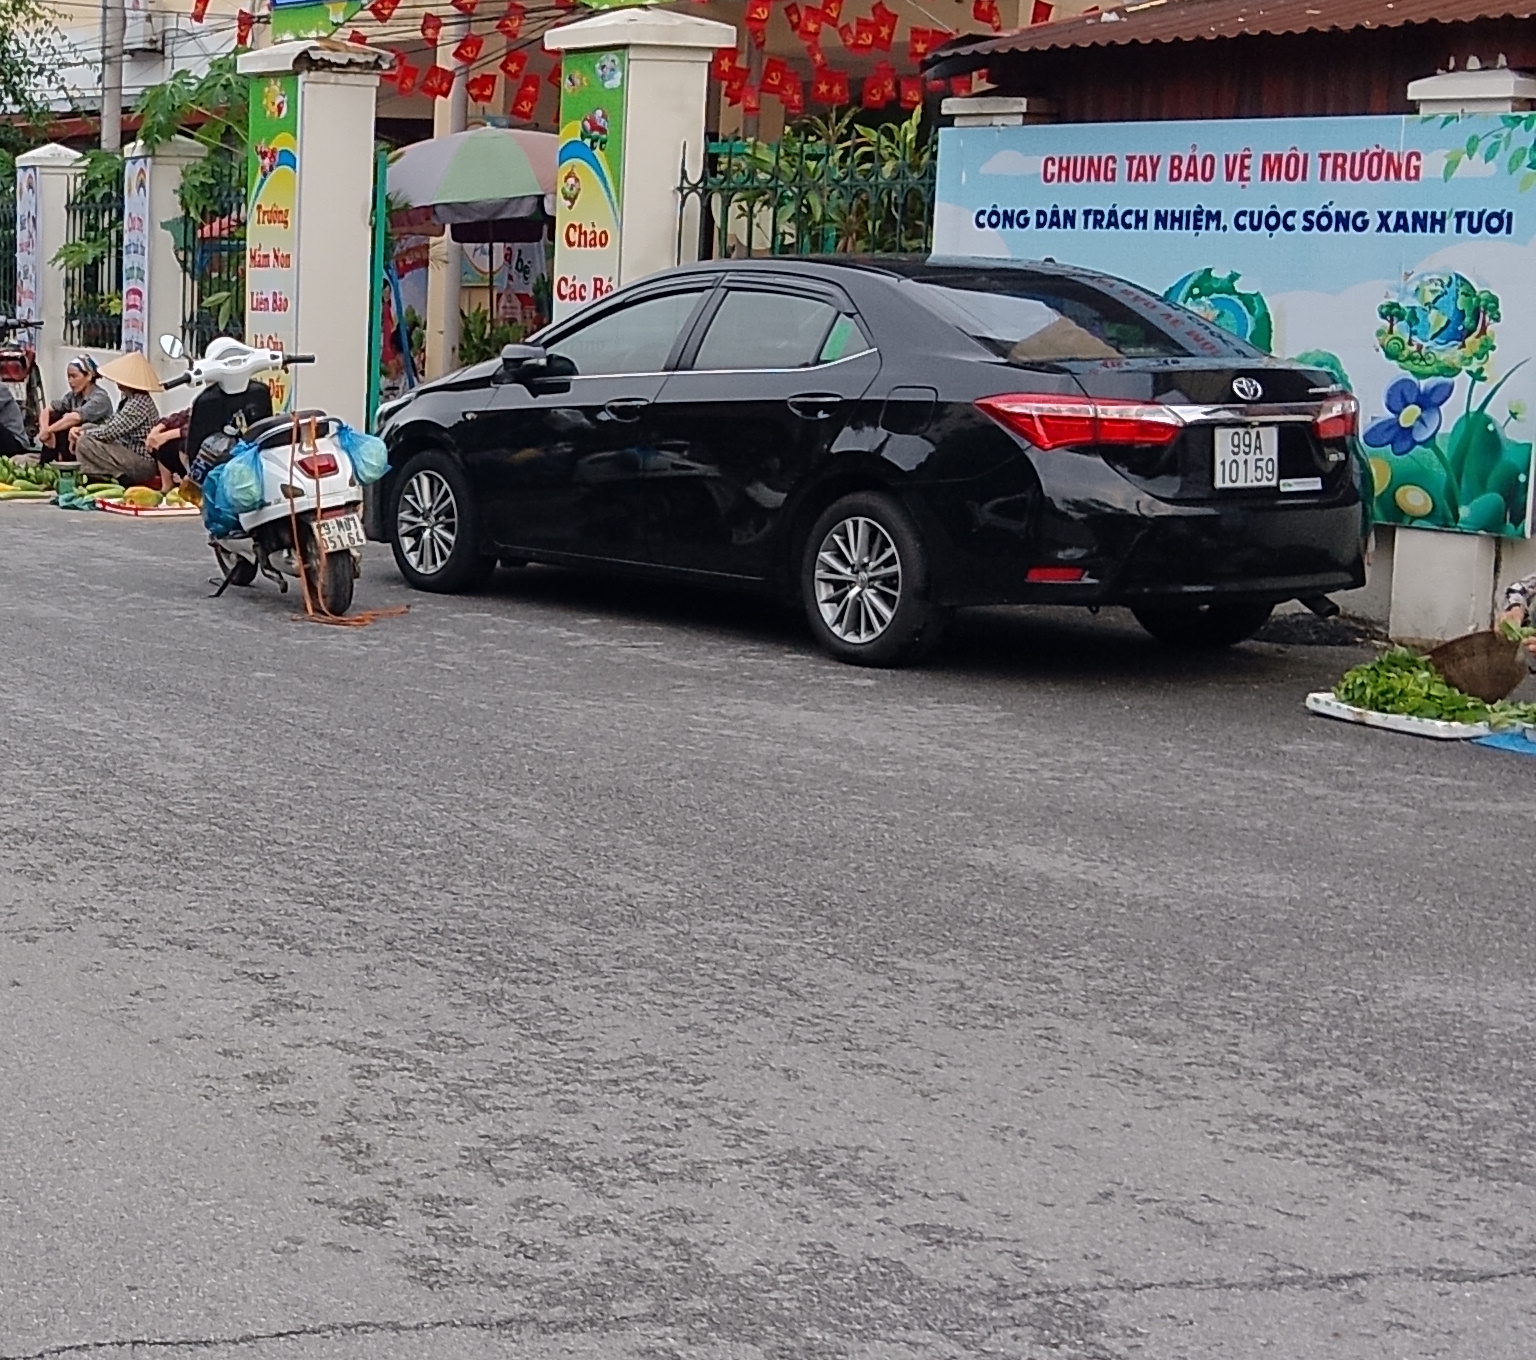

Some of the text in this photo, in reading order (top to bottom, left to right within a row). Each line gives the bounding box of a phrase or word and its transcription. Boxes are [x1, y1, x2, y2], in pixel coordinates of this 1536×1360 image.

[1042, 143, 1423, 190] CHUNG TAY BẢO VỆ MÔI TRƯỜNG
[974, 203, 1031, 230] CÔNG
[1035, 203, 1077, 230] DÂN
[1082, 203, 1148, 231] TRÁCH
[1233, 204, 1296, 238] CUỘC
[1301, 201, 1370, 232] SỐNG
[1375, 210, 1446, 233] XANH
[1453, 208, 1513, 235] TƯƠI
[564, 221, 609, 249] Chào
[272, 247, 291, 269] Non
[556, 274, 587, 302] Các
[1230, 430, 1263, 456] 99A
[1220, 457, 1275, 484] 101.59
